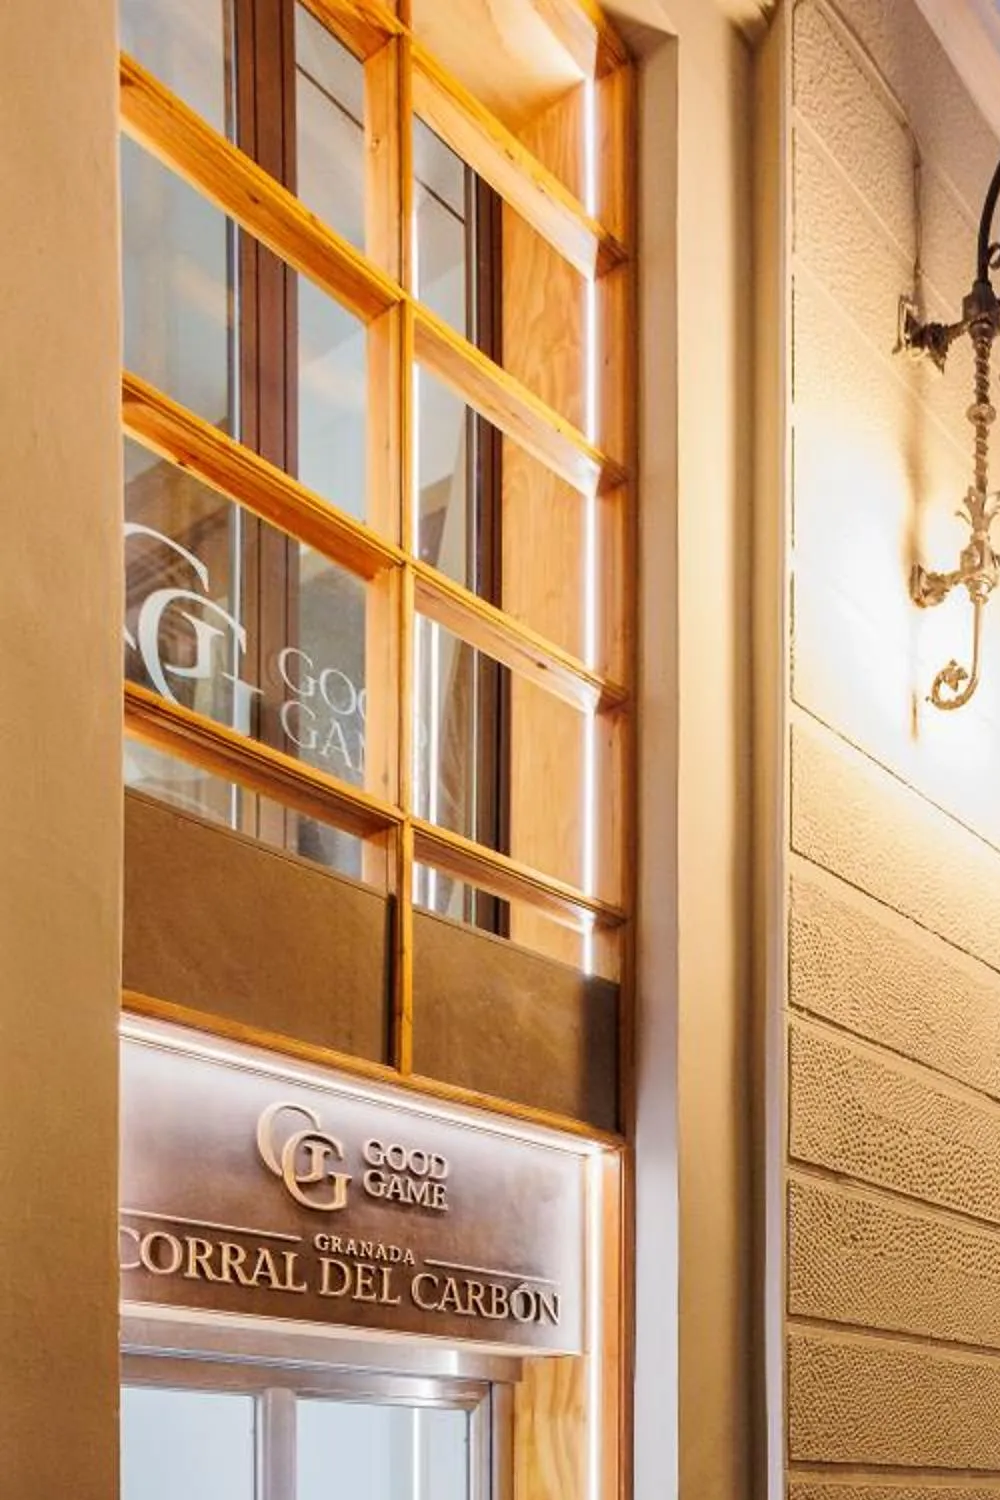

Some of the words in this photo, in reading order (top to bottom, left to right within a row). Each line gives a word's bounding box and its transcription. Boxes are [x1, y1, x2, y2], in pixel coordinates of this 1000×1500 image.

[281, 700, 364, 774] GA
[363, 1138, 448, 1181] GOOD
[363, 1169, 449, 1211] GAME
[313, 1233, 415, 1266] GRANADA
[318, 1257, 401, 1305] DEL
[410, 1272, 561, 1326] CARBÓN
